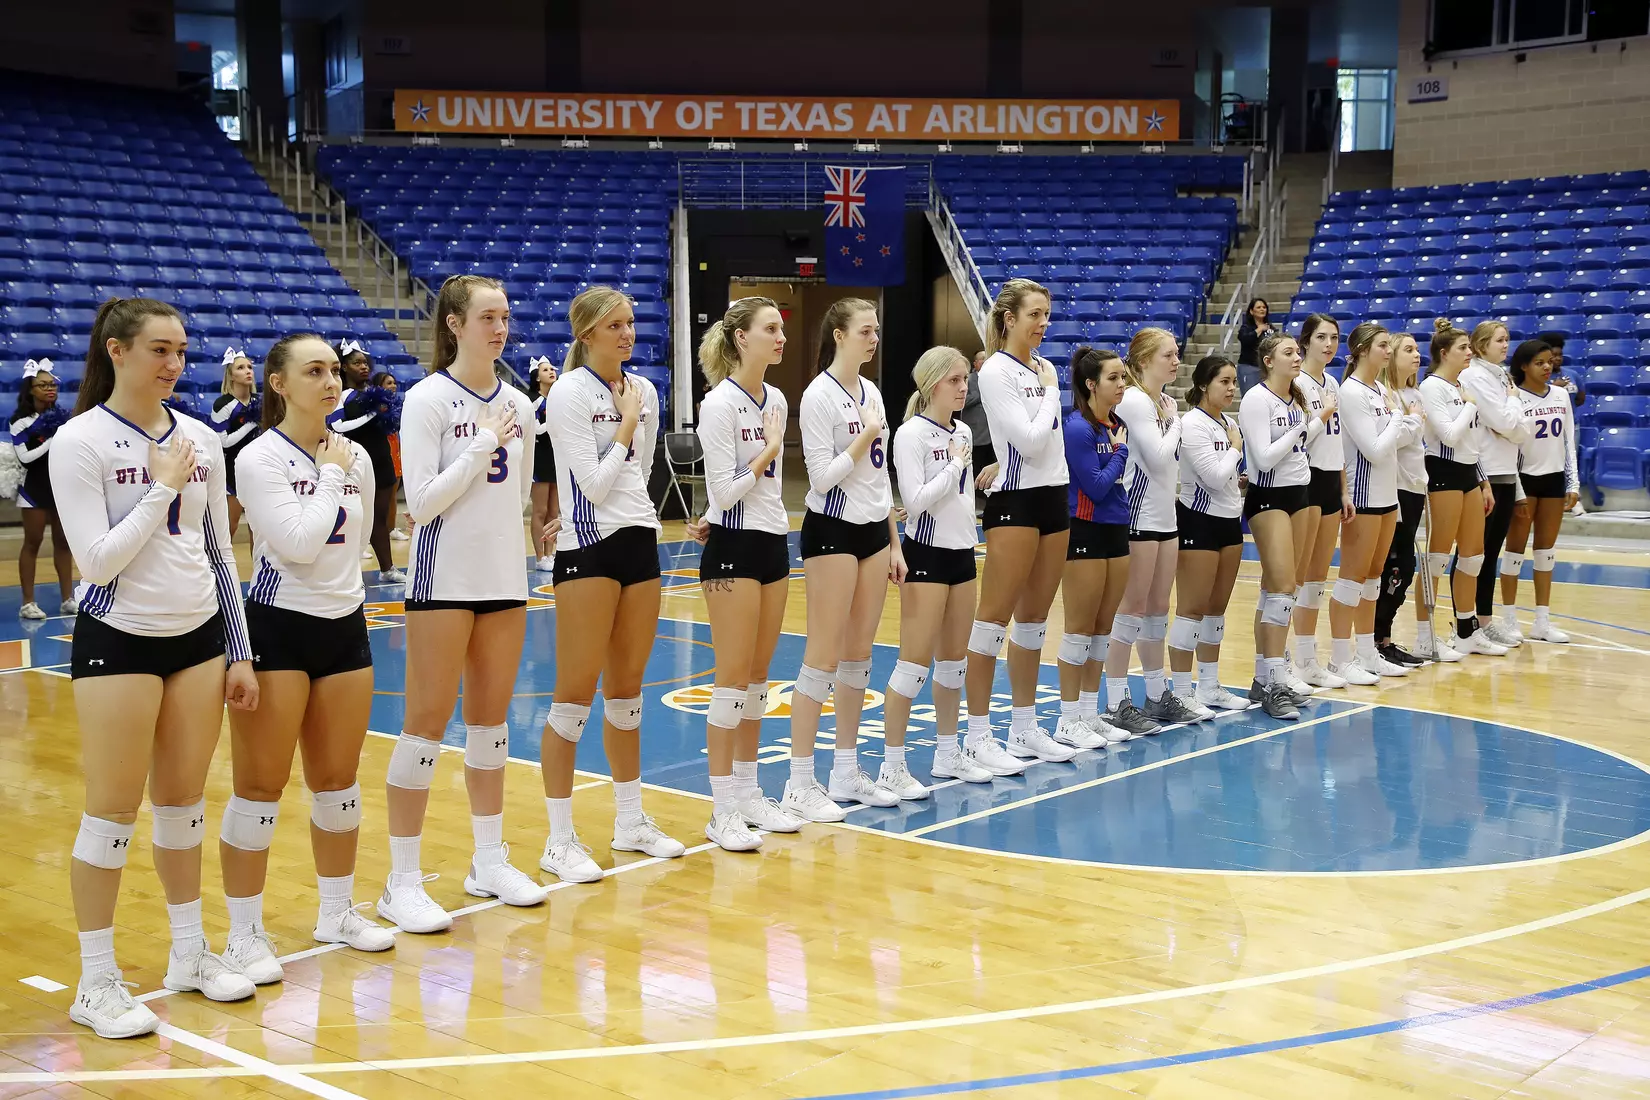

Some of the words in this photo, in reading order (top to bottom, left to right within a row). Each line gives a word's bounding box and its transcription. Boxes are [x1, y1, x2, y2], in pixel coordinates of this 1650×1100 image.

[1417, 80, 1440, 95] 108
[436, 97, 662, 129] UNIVERSITY
[675, 101, 730, 130] OF
[735, 102, 853, 132] TEXAS
[866, 104, 911, 132] AT
[923, 104, 1140, 135] ARLINGTON
[454, 422, 469, 439] UT
[741, 428, 753, 442] UT
[848, 421, 861, 435] UT
[1535, 417, 1563, 439] 20
[870, 437, 884, 469] 6
[1097, 443, 1106, 454] UT
[1214, 441, 1225, 451] UT
[933, 449, 945, 461] UT
[486, 446, 509, 484] 3
[115, 467, 137, 485] UT
[325, 505, 346, 545] 2
